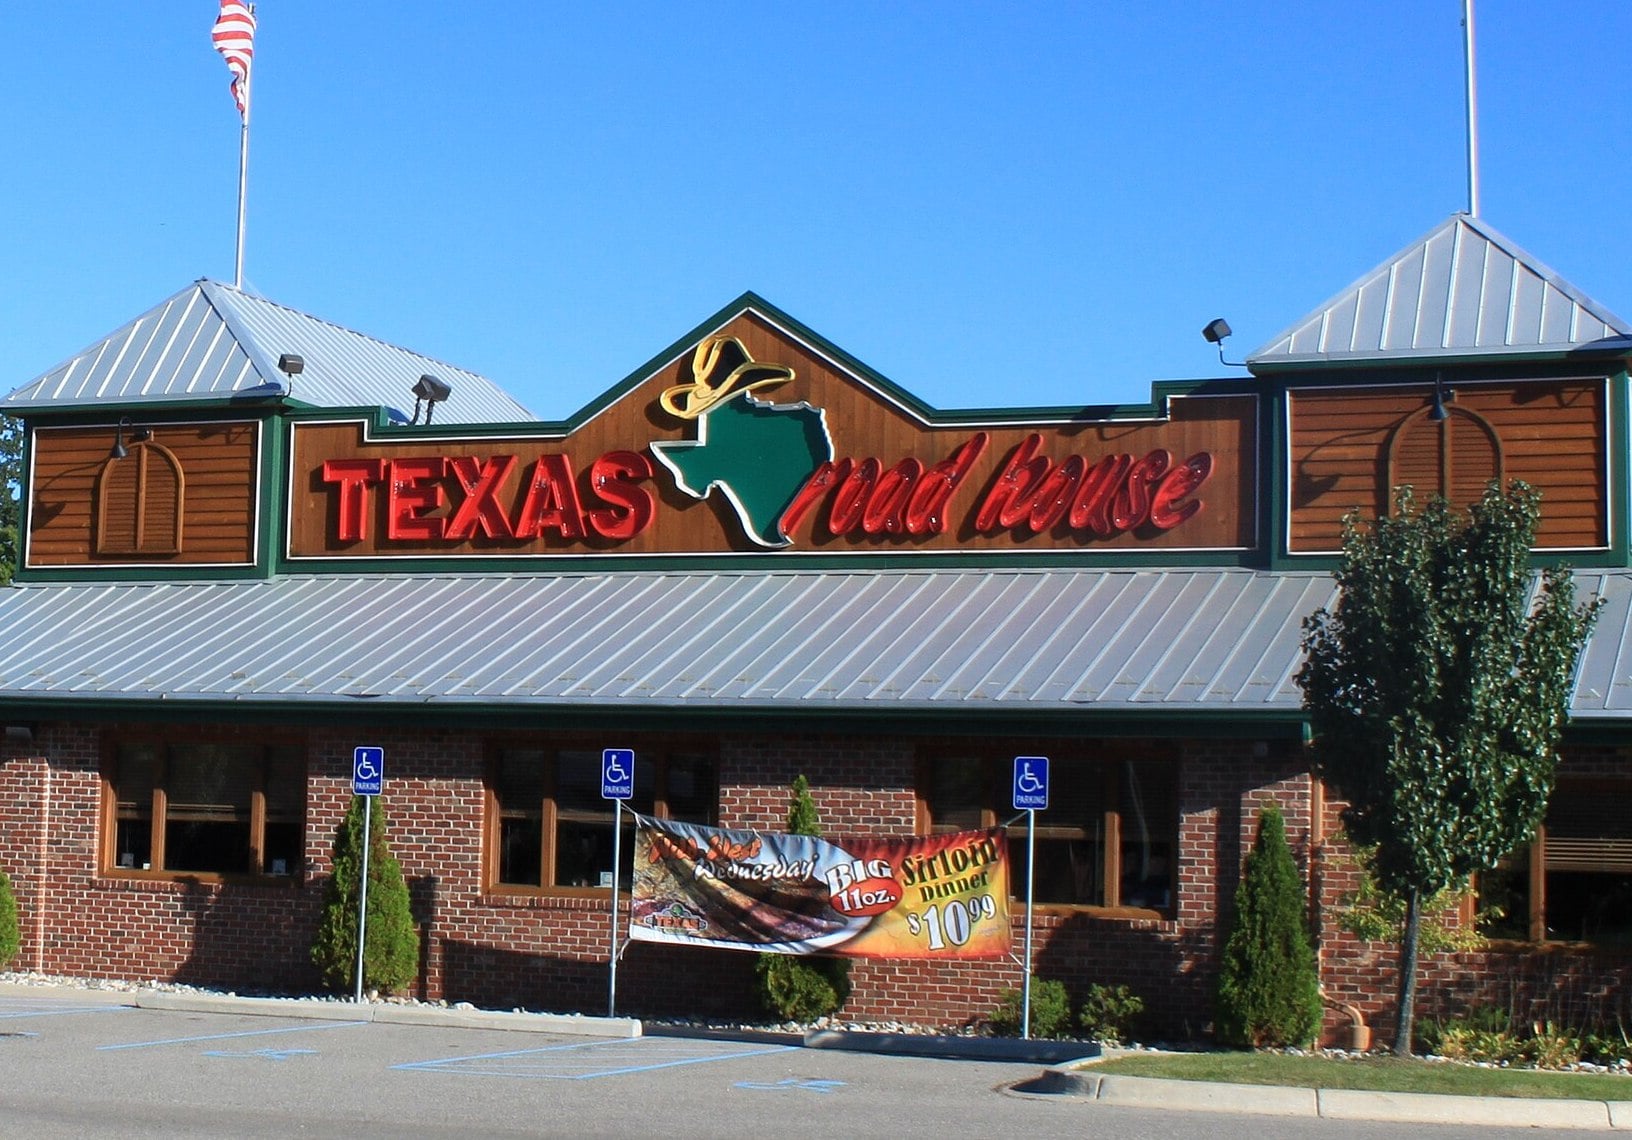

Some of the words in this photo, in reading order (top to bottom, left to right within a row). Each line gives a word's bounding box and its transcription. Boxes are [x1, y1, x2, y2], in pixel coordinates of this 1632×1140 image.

[323, 450, 657, 541] TEXAS
[355, 782, 380, 791] PARKING
[604, 785, 631, 795] PARKING
[1016, 795, 1046, 805] PARKING
[694, 852, 821, 882] Wednesday
[901, 836, 998, 887] Sirloin
[825, 859, 893, 897] BIG
[919, 870, 989, 902] Dinner
